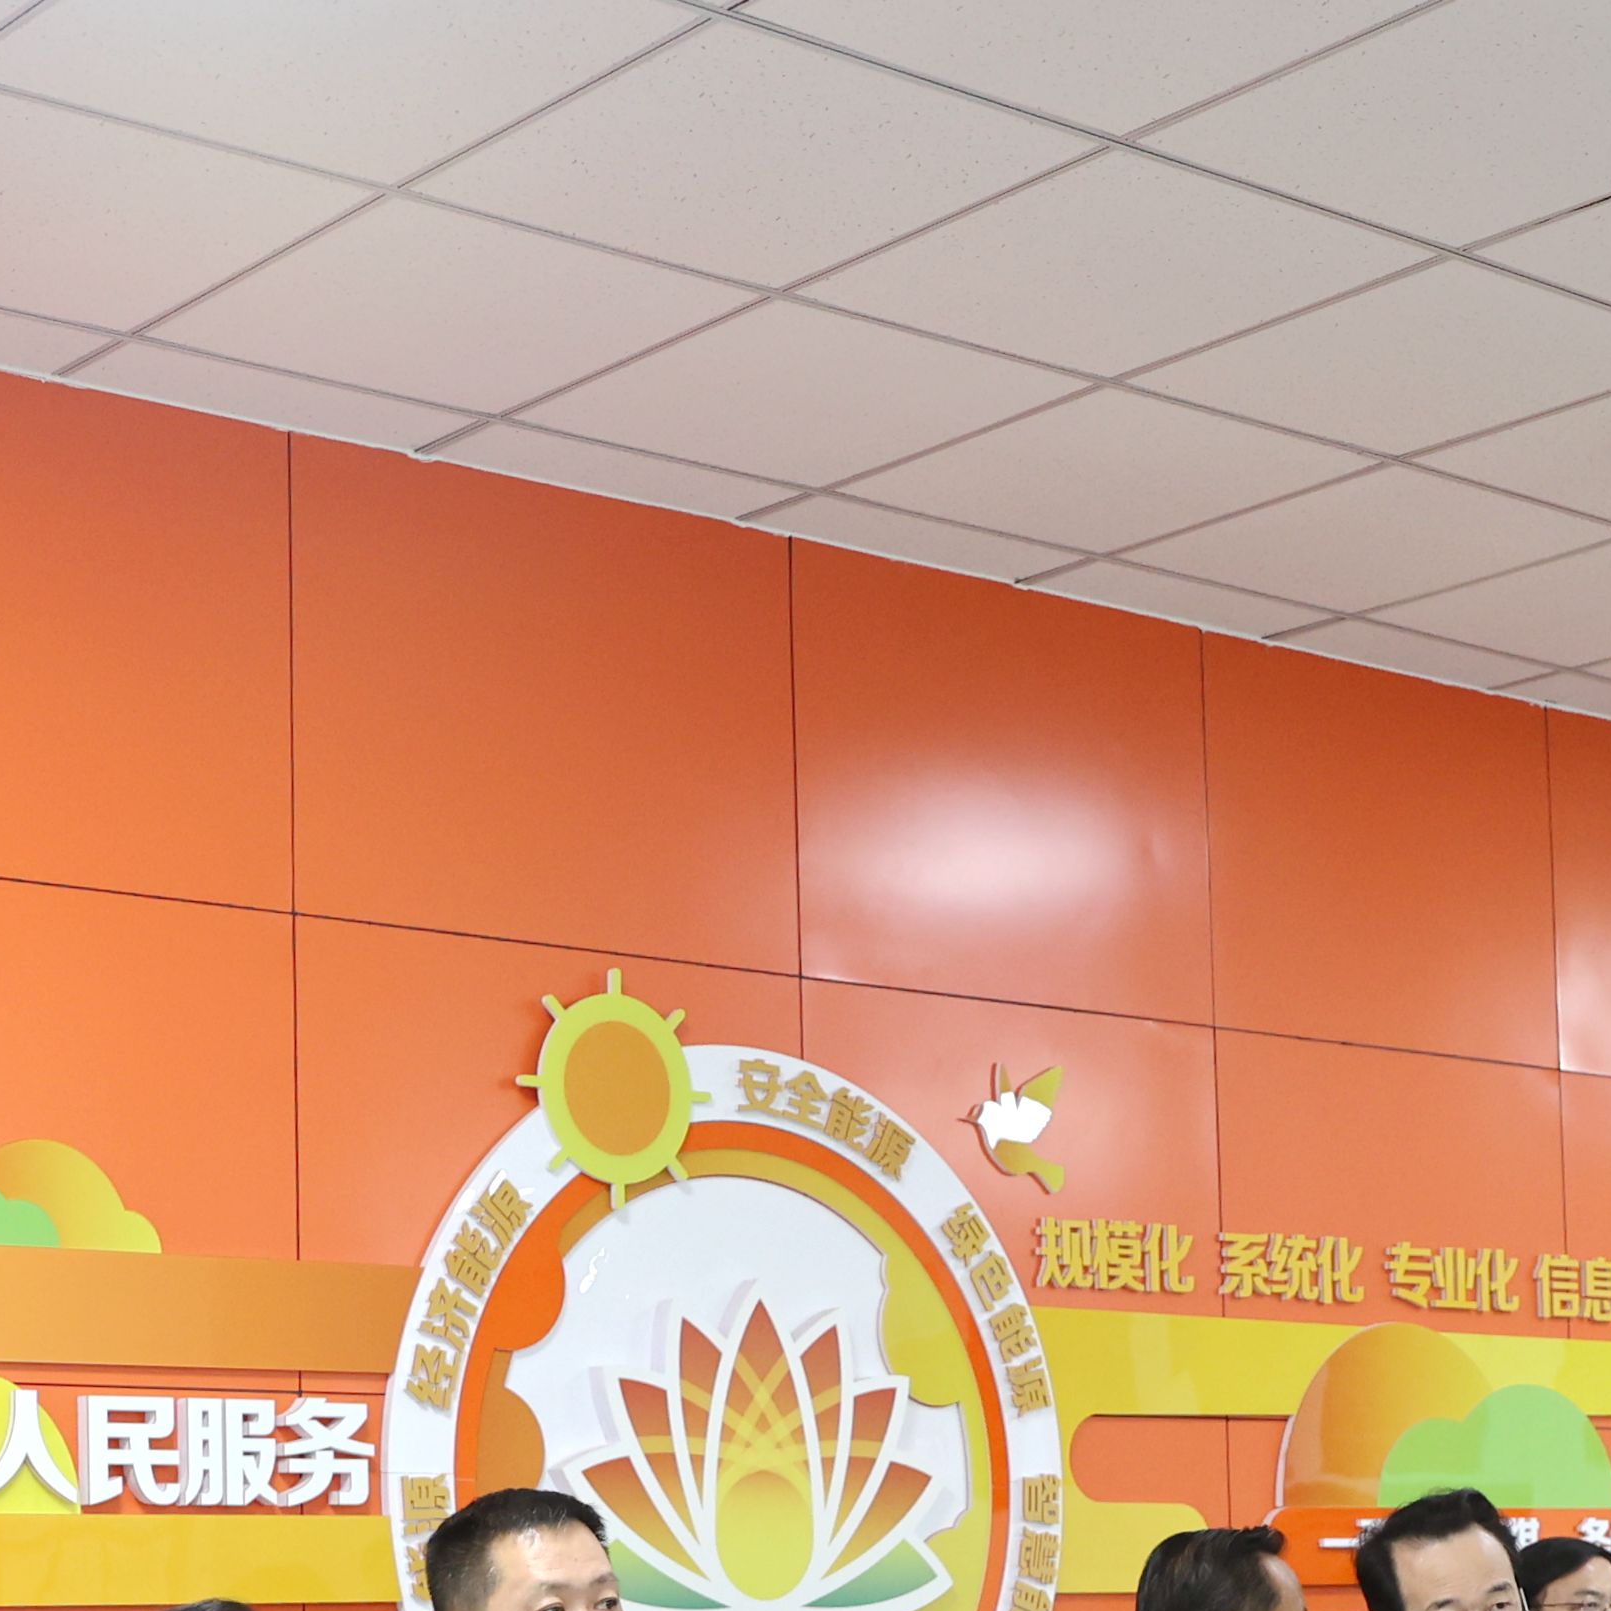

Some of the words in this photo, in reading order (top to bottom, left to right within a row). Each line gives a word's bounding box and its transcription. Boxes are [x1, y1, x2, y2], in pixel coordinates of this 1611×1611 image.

[736, 1059, 916, 1182] 安全能源
[405, 1177, 534, 1411] 经济能源
[940, 1201, 1052, 1416] 绿色能源
[1034, 1216, 1196, 1294] 规模化
[1218, 1232, 1366, 1304] 系统化
[1383, 1241, 1521, 1313] 专业化
